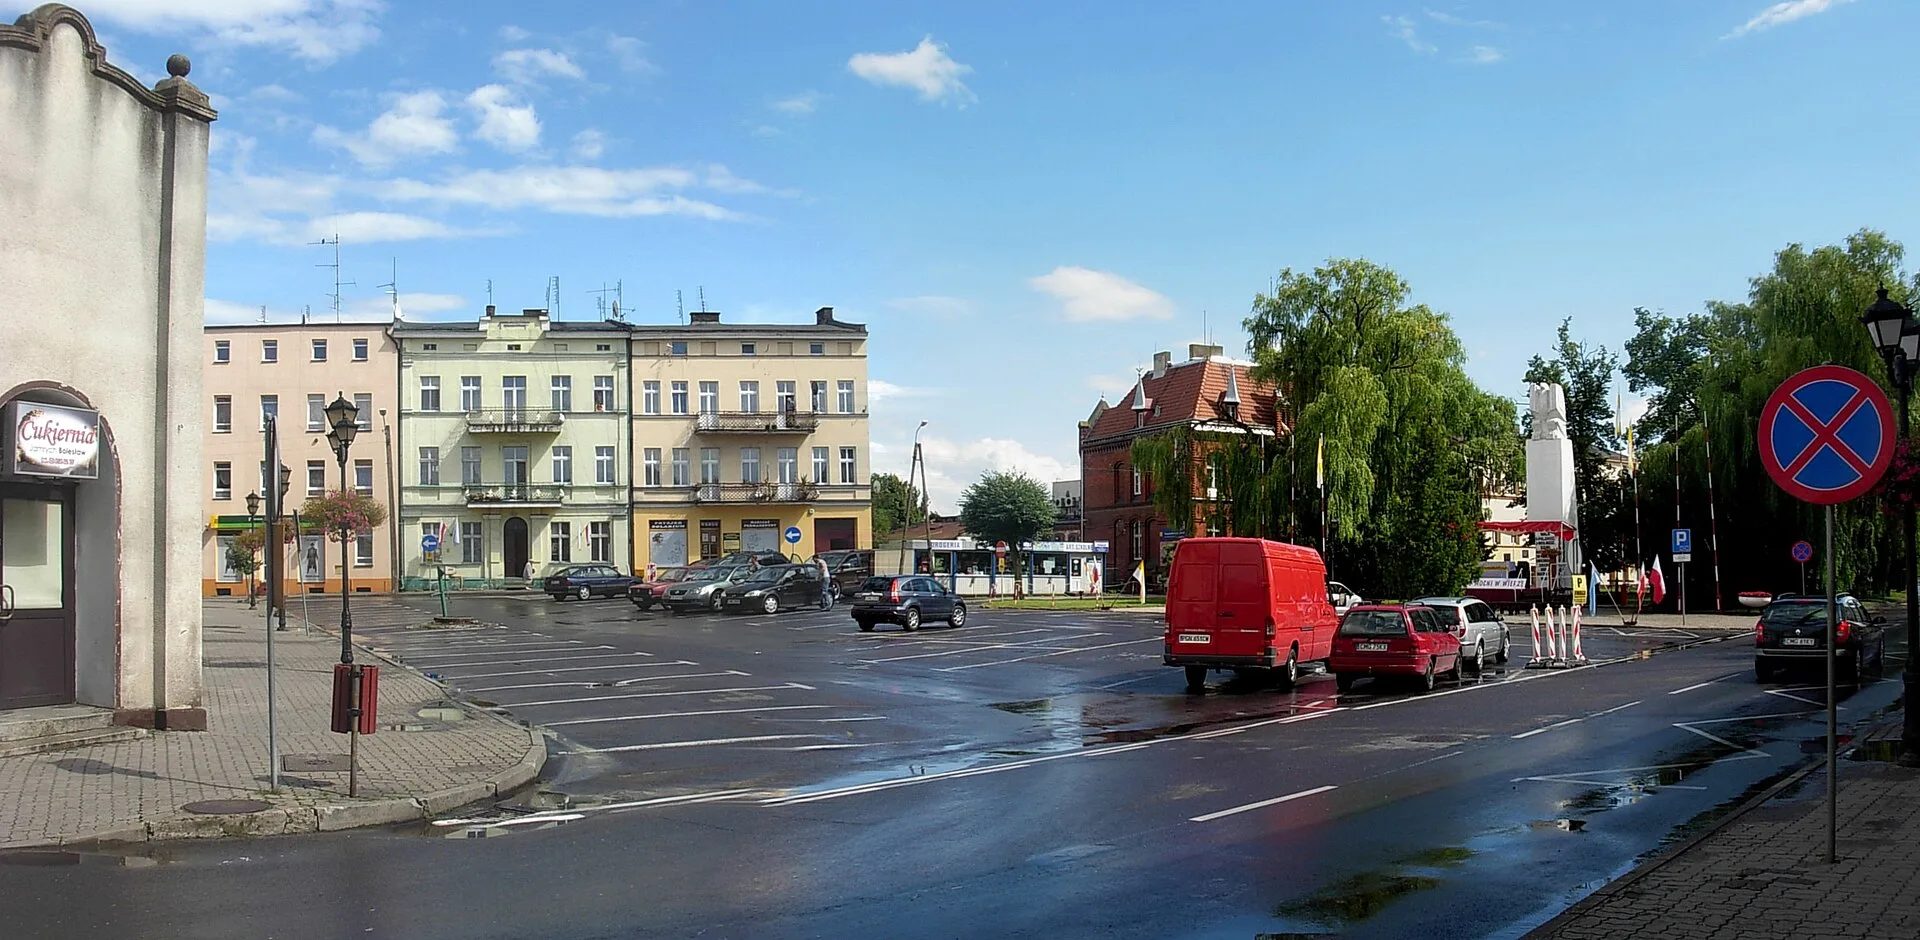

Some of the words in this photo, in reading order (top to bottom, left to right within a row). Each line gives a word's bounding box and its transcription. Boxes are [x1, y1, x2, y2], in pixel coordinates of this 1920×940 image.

[21, 419, 95, 446] Cukiernia
[1676, 531, 1687, 546] P
[1577, 577, 1583, 588] P
